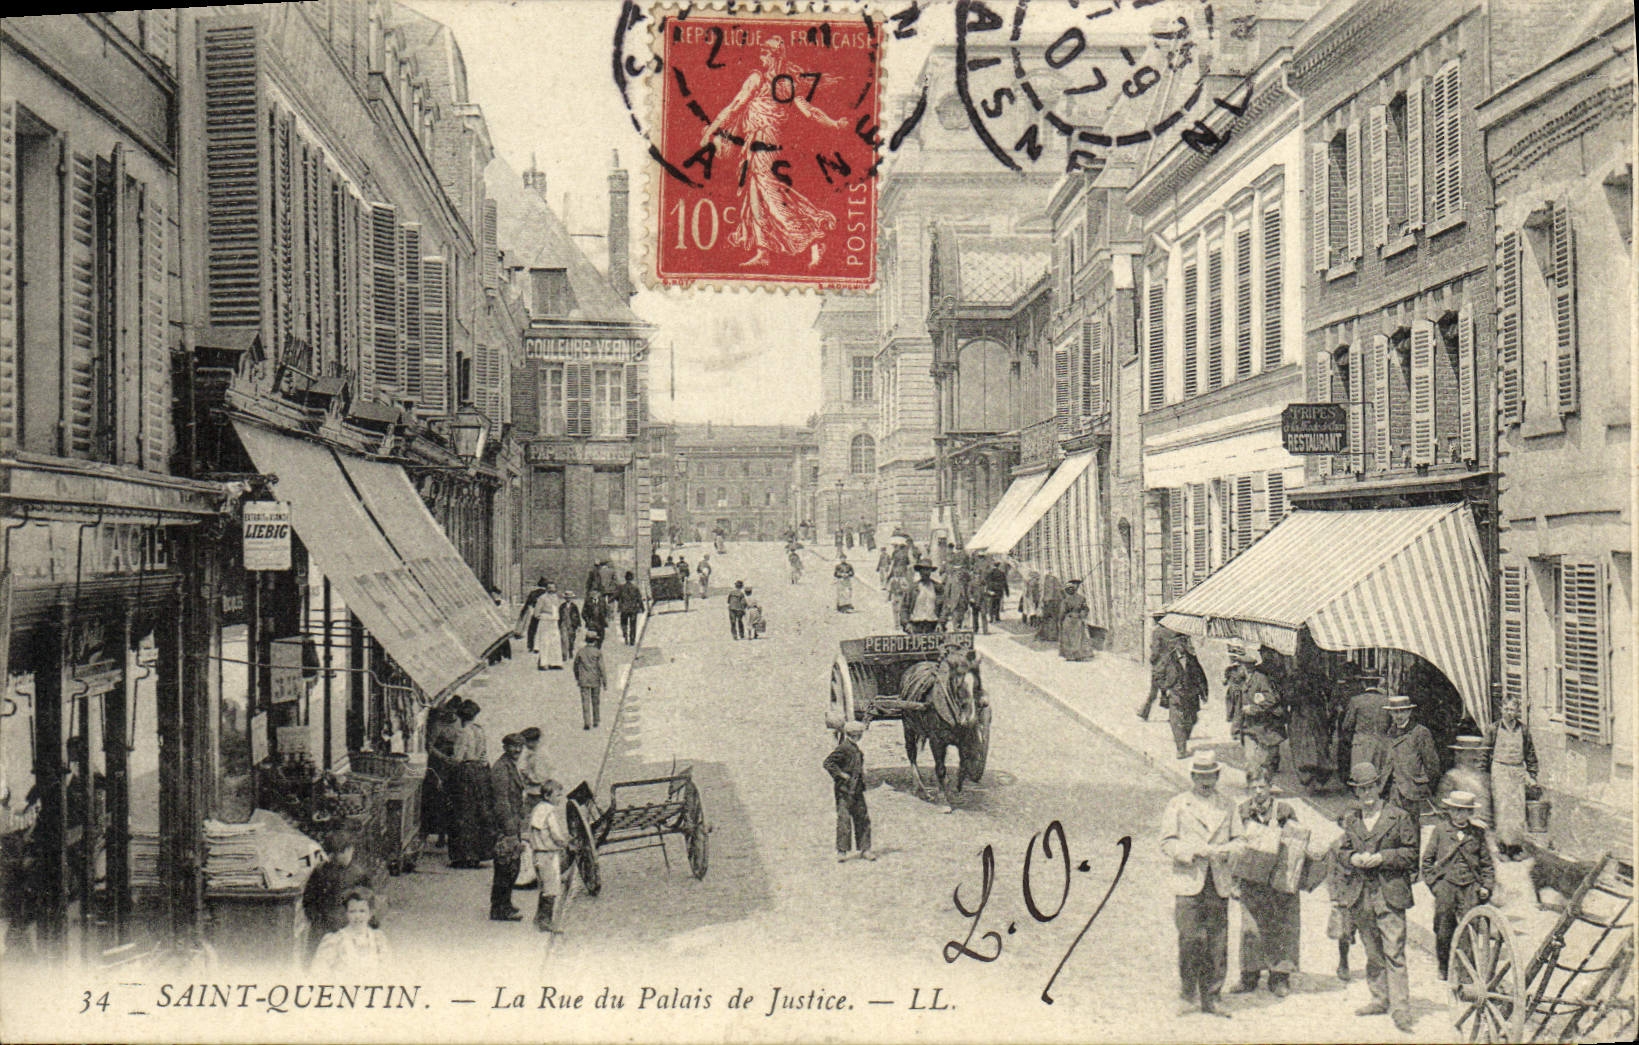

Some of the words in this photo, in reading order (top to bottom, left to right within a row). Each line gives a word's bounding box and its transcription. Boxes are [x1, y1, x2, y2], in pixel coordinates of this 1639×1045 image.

[674, 26, 763, 47] EPULIQUE
[771, 72, 822, 104] 07
[846, 182, 868, 267] POSTES
[526, 338, 592, 359] COULEURS
[597, 338, 645, 361] VERNIS
[1289, 406, 1337, 420] TRIPES
[1287, 433, 1343, 452] RESTAURANT
[245, 524, 289, 539] LIEBIG
[865, 632, 973, 653] PERROT-DESCPS
